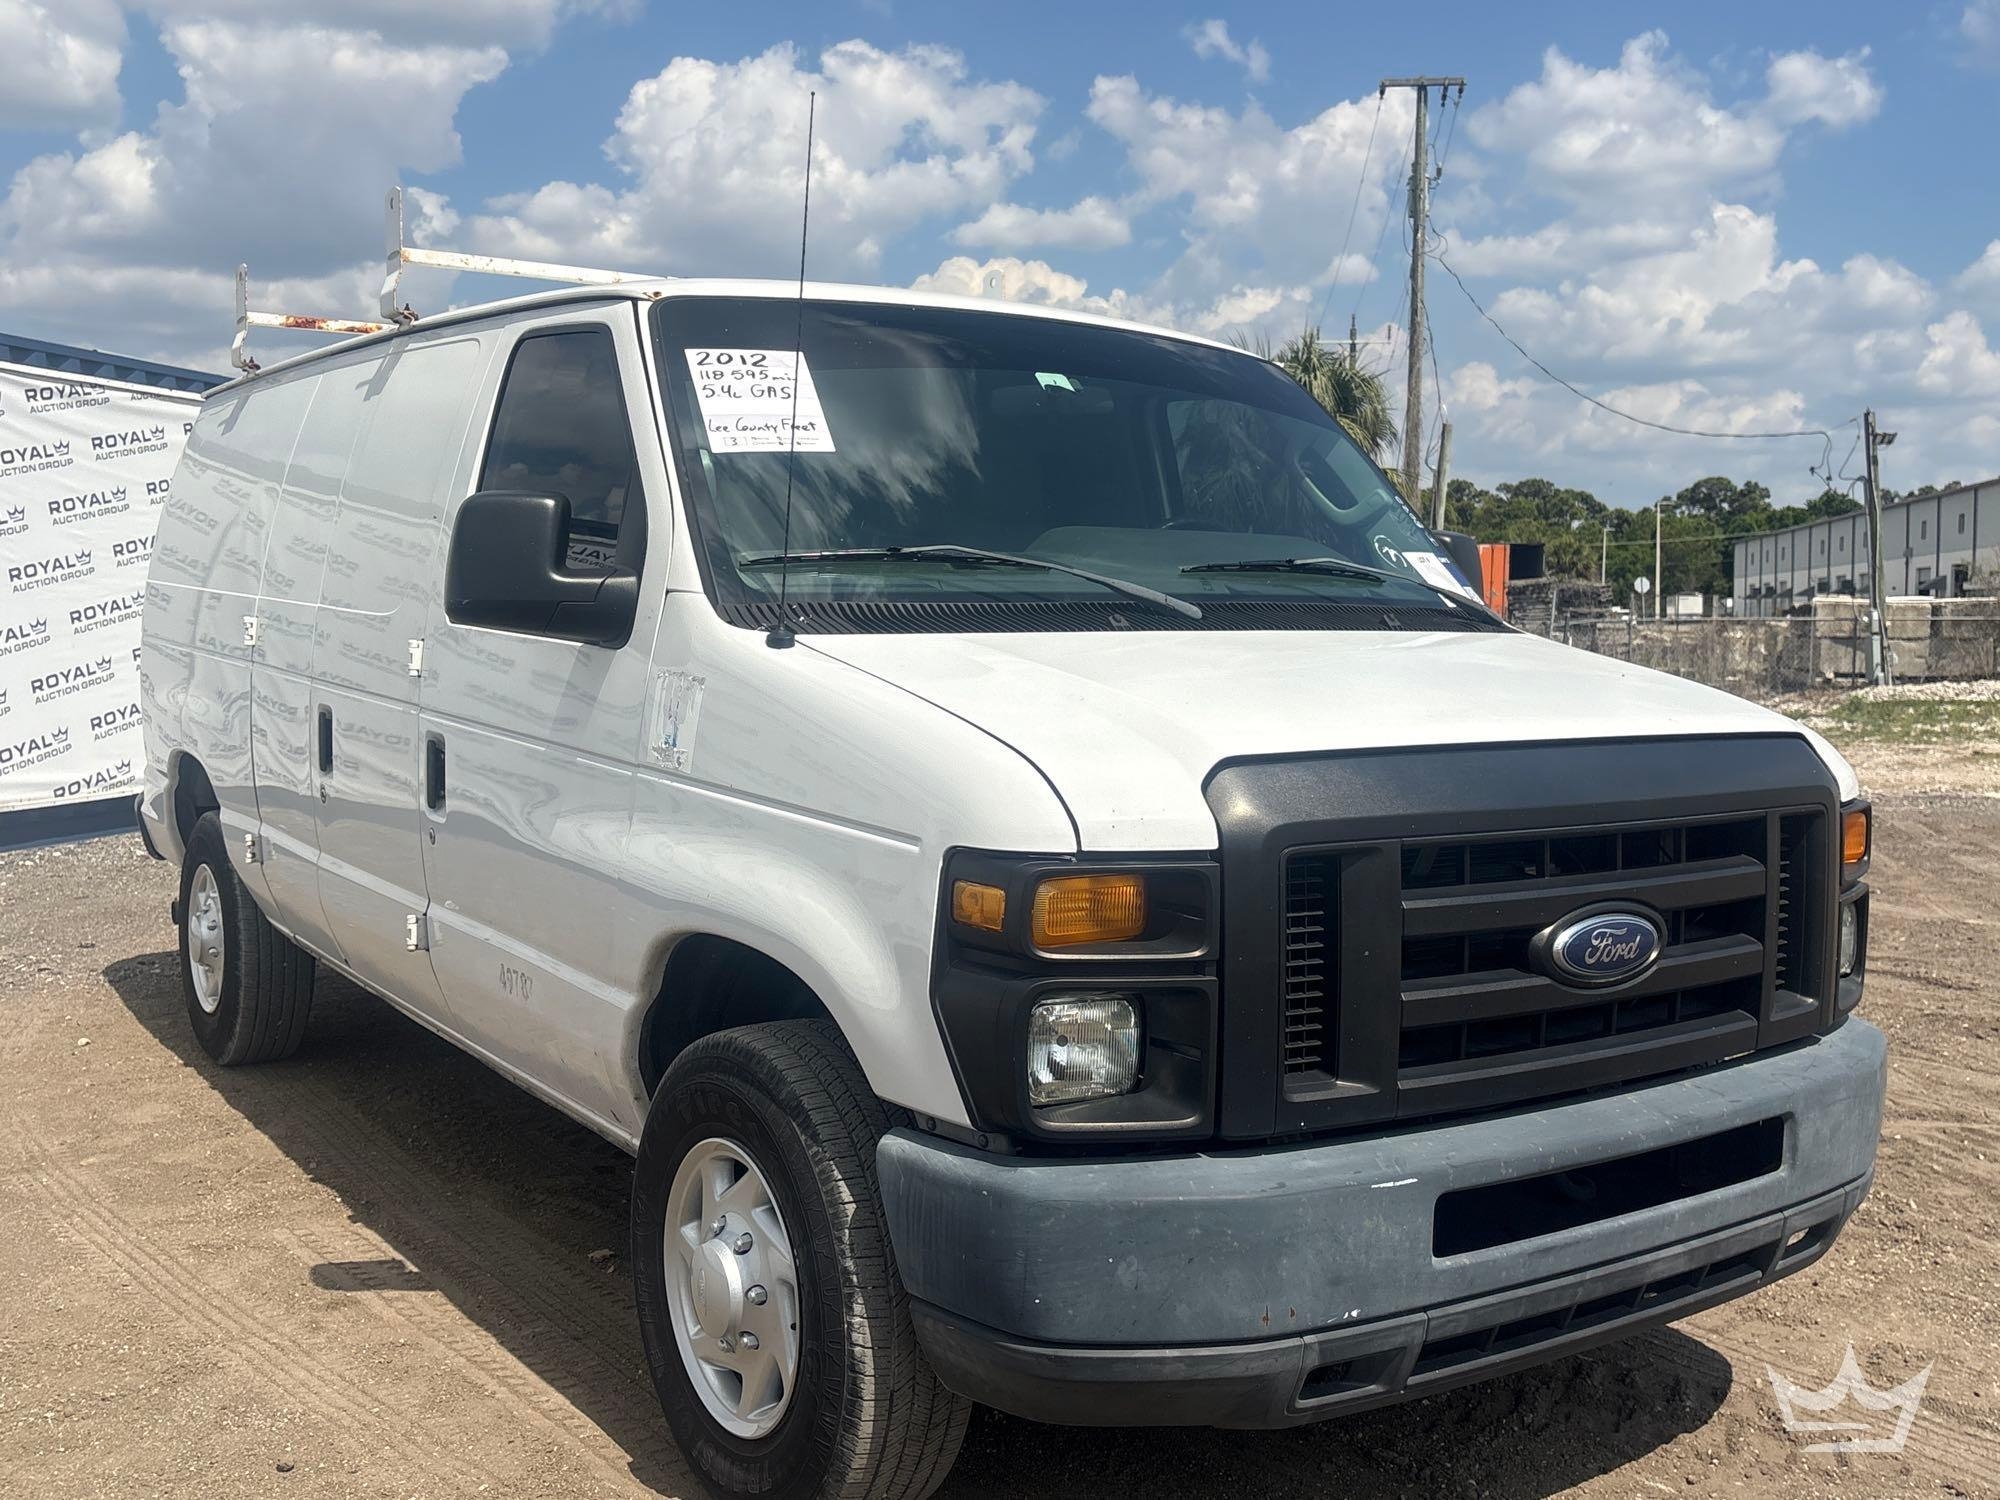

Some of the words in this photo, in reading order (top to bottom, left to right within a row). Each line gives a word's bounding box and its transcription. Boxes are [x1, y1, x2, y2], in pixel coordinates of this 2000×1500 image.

[696, 351, 769, 368] 2012
[24, 383, 93, 403] ROYAL
[750, 384, 792, 400] GAS
[29, 402, 74, 414] AUCTION
[75, 397, 110, 408] GROUP
[708, 418, 731, 433] Lee
[735, 416, 779, 434] County
[91, 429, 151, 451] ROYAL
[0, 444, 55, 464] OYAL
[95, 447, 137, 462] AUCTION
[137, 442, 168, 454] GROUP
[0, 464, 37, 477] UCTION
[38, 458, 74, 471] GROUP
[48, 491, 112, 515] ROYAL
[52, 511, 96, 526] AUCTION
[97, 503, 130, 517] GROUP
[0, 524, 29, 537] ROUP
[112, 535, 155, 557] ROY
[8, 555, 76, 582] ROYAL
[116, 553, 152, 568] AUCTIO
[12, 577, 59, 594] AUCTION
[60, 566, 96, 582] GROUP
[69, 597, 133, 625] ROYAL
[73, 618, 117, 635] AUCTION
[117, 609, 144, 623] GROU
[14, 635, 51, 652] GROUP
[31, 662, 97, 694] ROYAL
[35, 684, 80, 705] AUCTION
[81, 672, 115, 690] GROUP
[90, 703, 141, 731] ROYA
[94, 720, 135, 741] AUCTION
[0, 735, 53, 764] OYAL
[0, 756, 35, 776] CTION
[36, 743, 72, 762] GROUP
[101, 775, 136, 793] GROUP
[1584, 927, 1642, 965] Ford
[499, 963, 533, 1000] 49787
